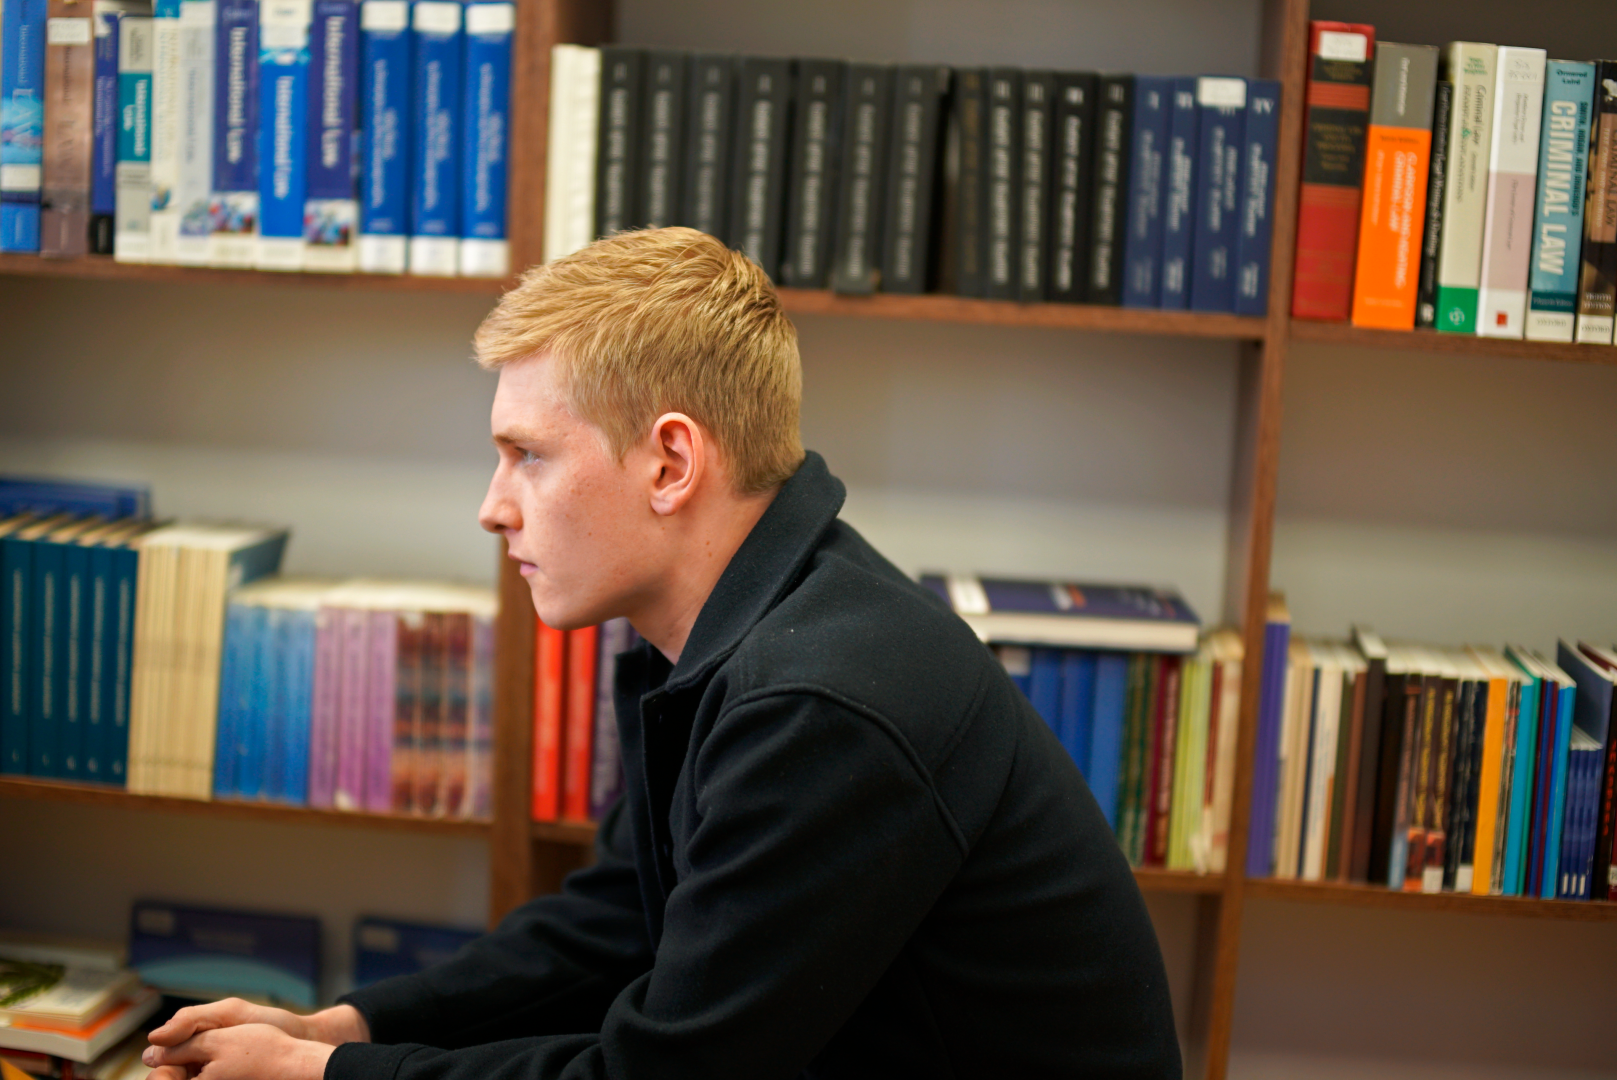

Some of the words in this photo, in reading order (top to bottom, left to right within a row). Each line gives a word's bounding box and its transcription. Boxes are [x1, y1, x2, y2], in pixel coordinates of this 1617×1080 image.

[228, 27, 248, 127] International
[322, 16, 346, 126] International
[274, 76, 294, 166] International
[1474, 84, 1487, 124] Criminal
[227, 129, 244, 163] Law
[321, 129, 343, 168] Law
[1472, 126, 1485, 145] Law
[1541, 100, 1577, 217] CRIMINAL
[273, 167, 290, 199] Law
[1605, 199, 1617, 228] LAW
[1538, 223, 1567, 276] LAW
